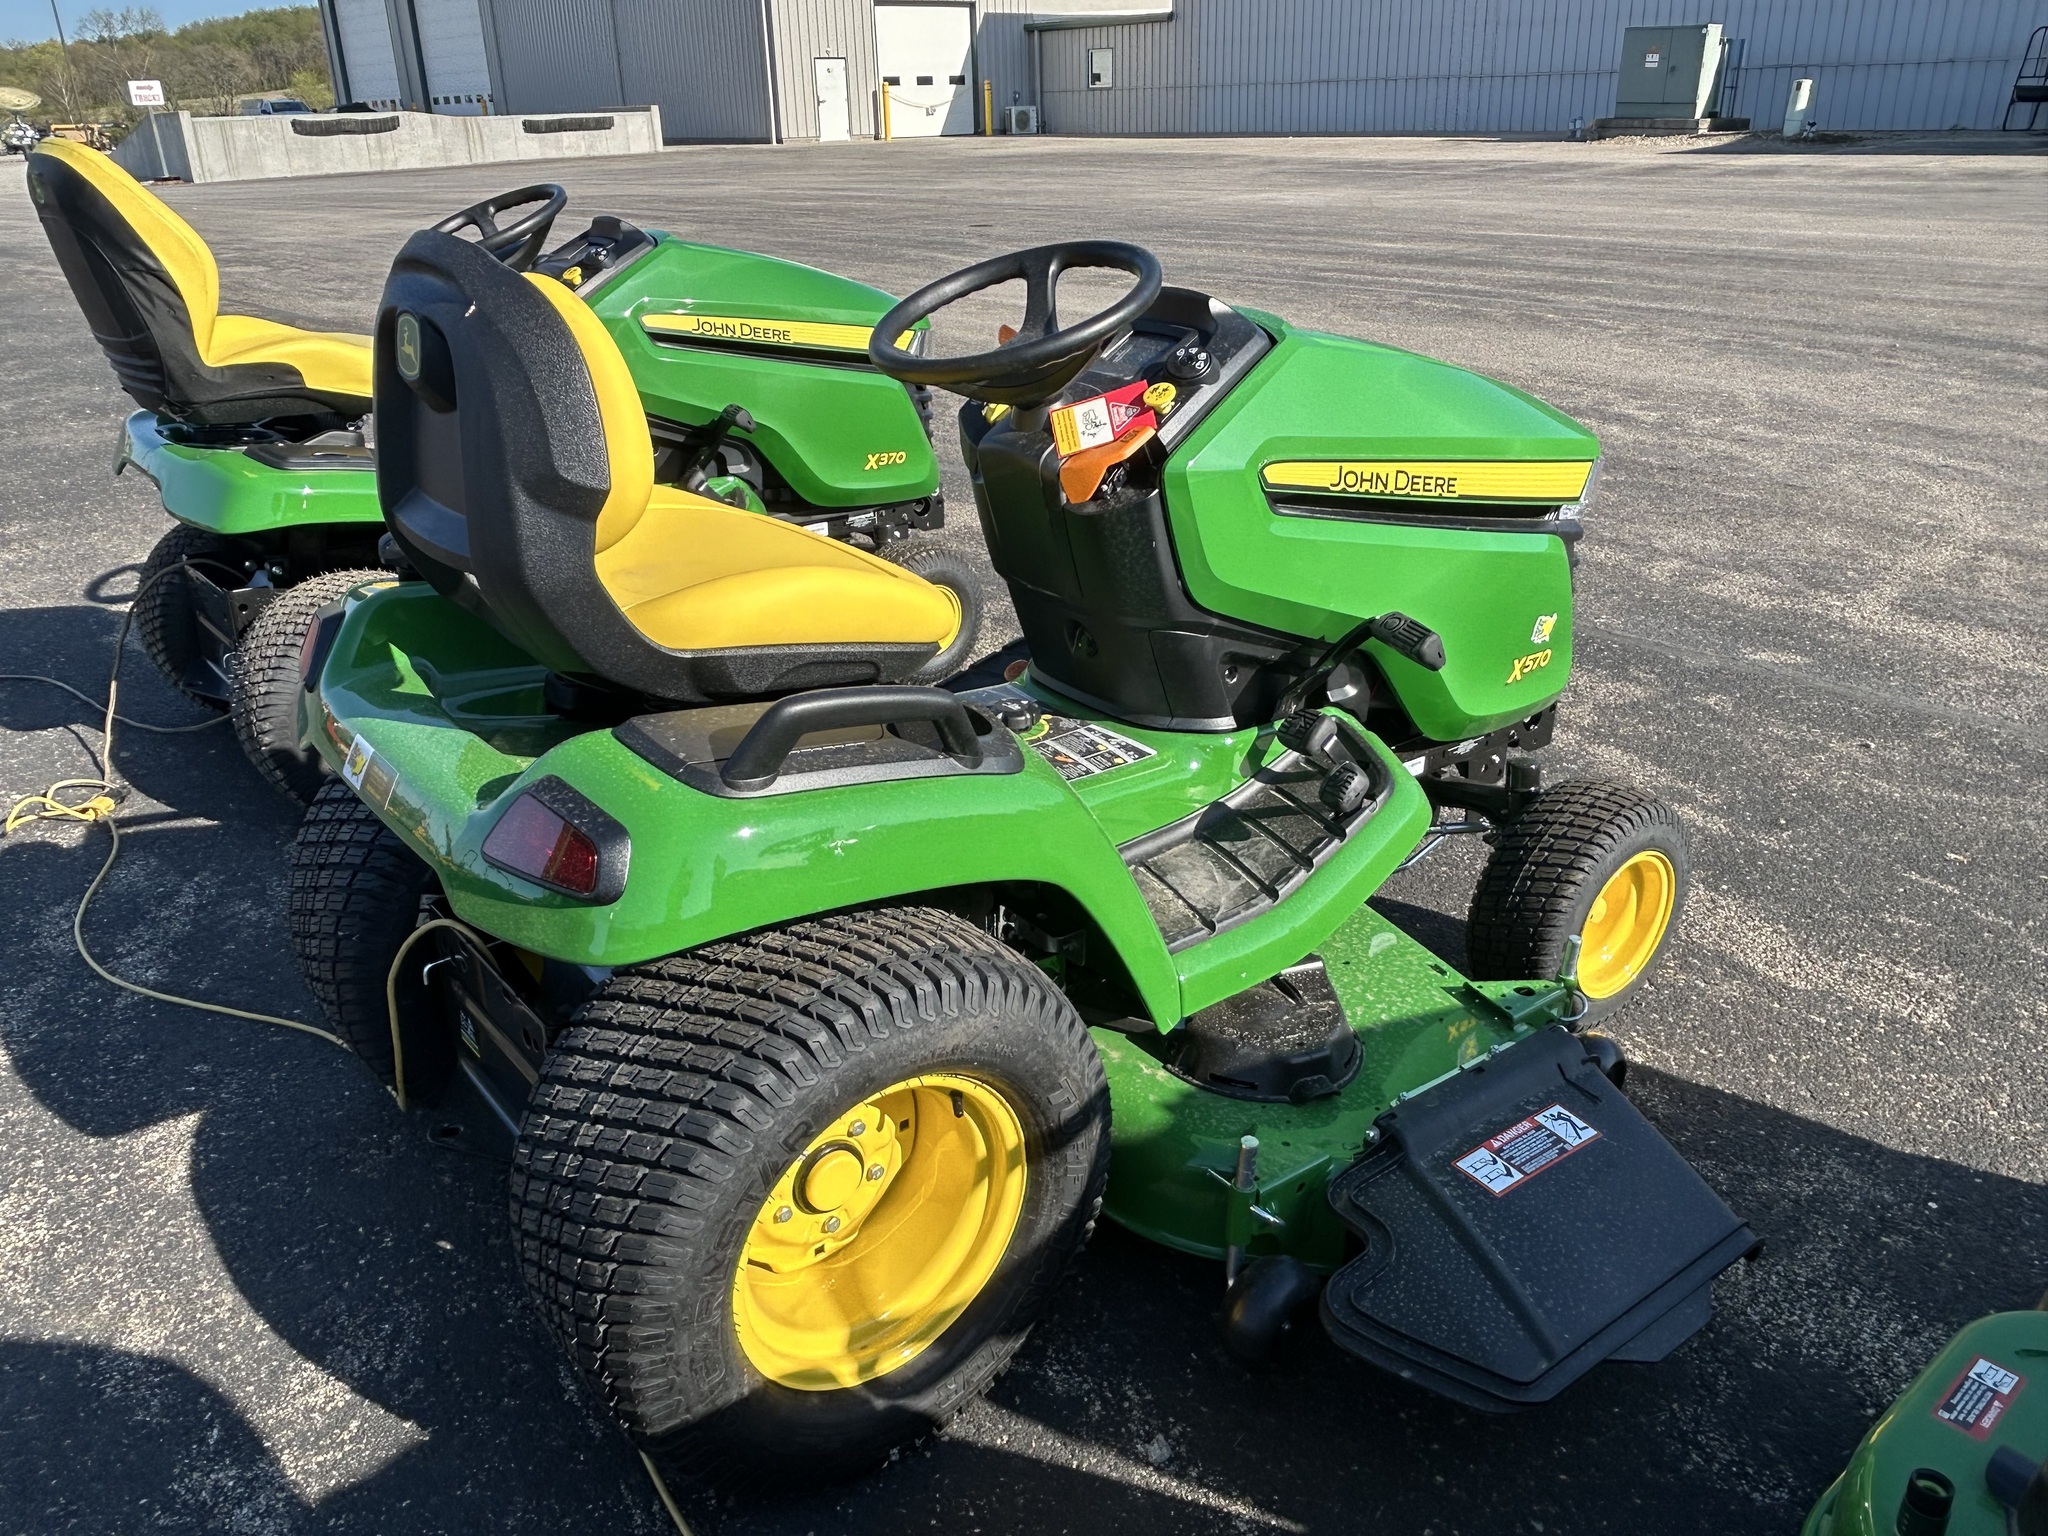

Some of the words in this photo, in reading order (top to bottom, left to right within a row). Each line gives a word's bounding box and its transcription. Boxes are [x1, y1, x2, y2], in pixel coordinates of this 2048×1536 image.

[692, 318, 736, 336] JOHN
[740, 323, 792, 342] DEERE
[863, 450, 907, 471] X370
[1330, 465, 1390, 491] JOHN
[1394, 470, 1458, 494] DEERE
[1504, 648, 1552, 685] X570
[1498, 1121, 1533, 1146] DANGER
